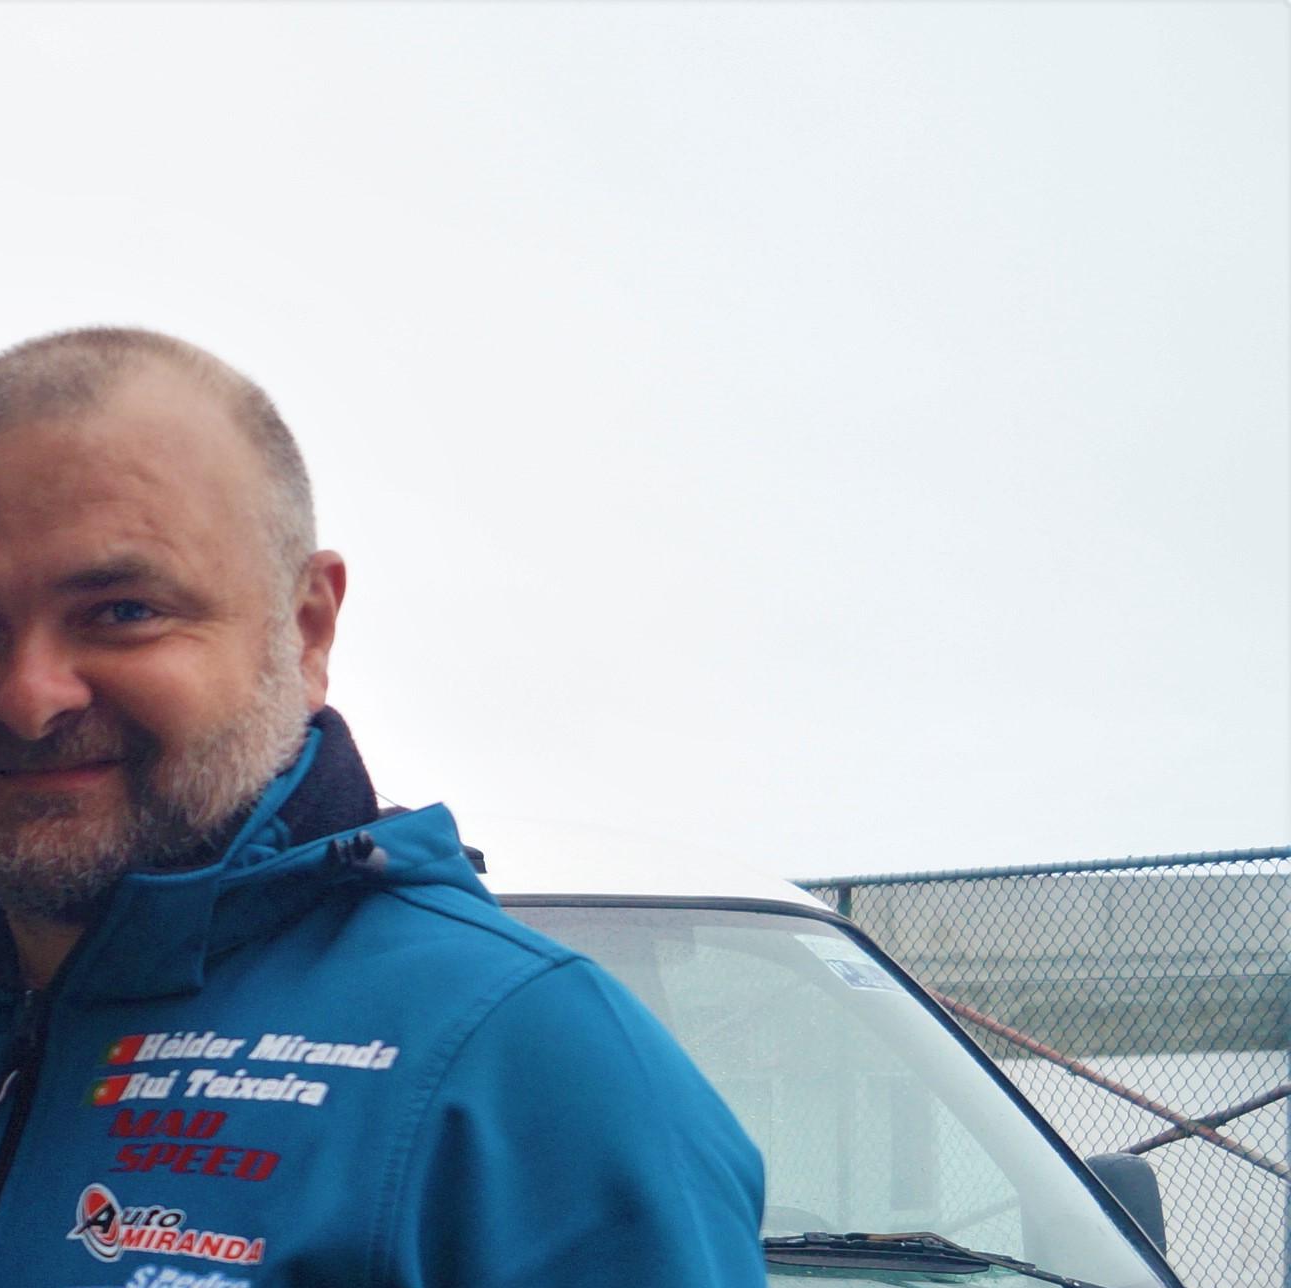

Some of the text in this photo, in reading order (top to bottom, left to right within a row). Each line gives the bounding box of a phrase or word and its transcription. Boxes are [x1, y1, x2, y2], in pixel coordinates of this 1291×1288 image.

[133, 1032, 399, 1070] Hélder Miranda
[120, 1068, 329, 1106] Rui Teixeira
[109, 1108, 228, 1139] MAD
[109, 1143, 281, 1181] SPEED
[75, 1202, 182, 1234] Auto
[118, 1228, 265, 1262] MIRANDA
